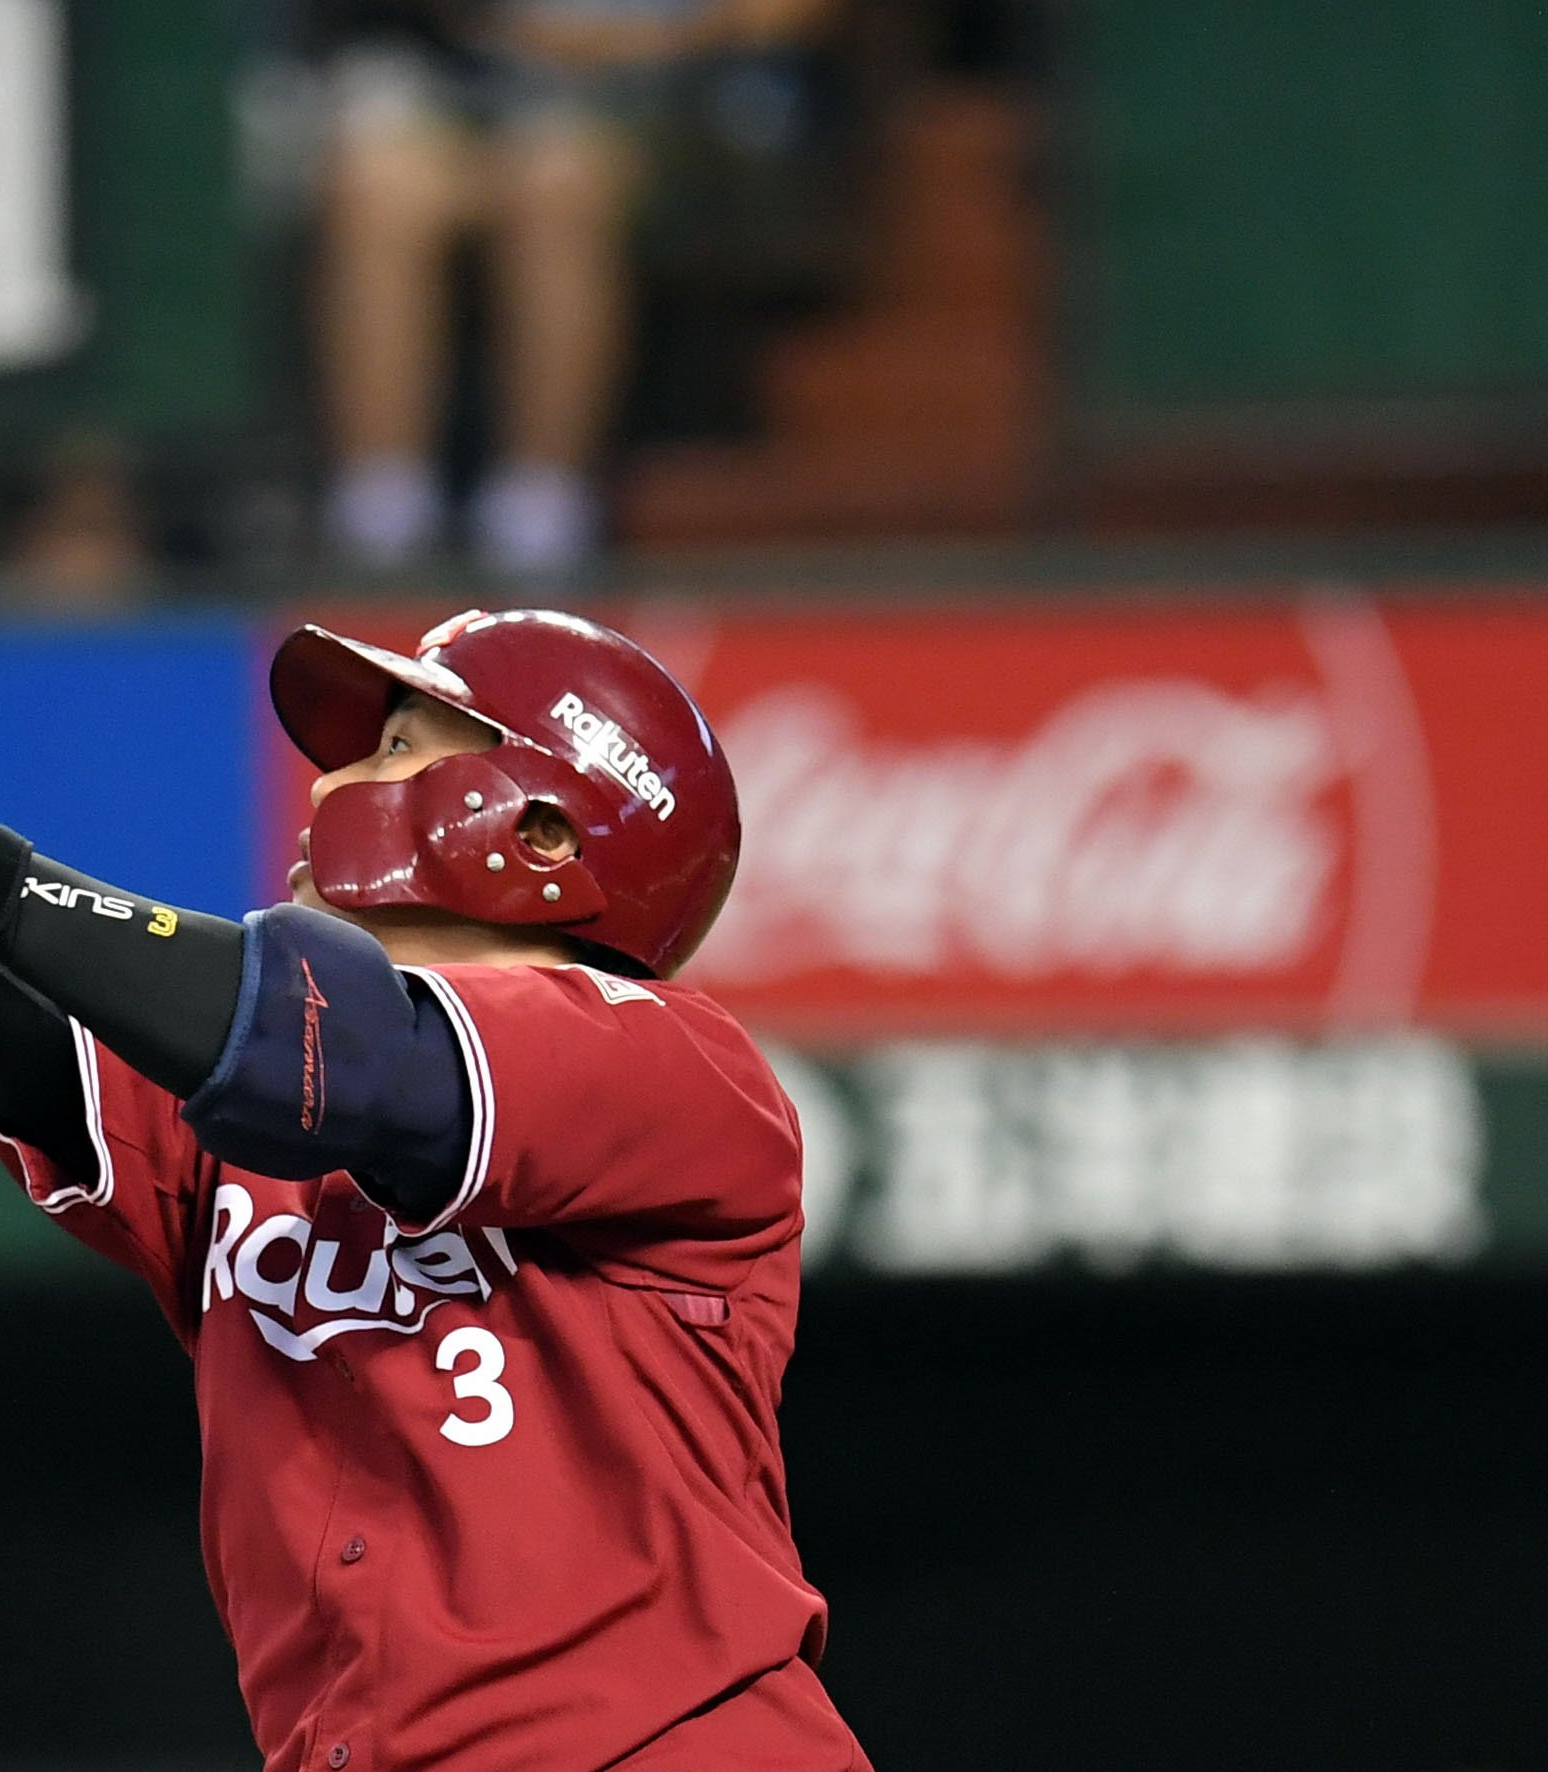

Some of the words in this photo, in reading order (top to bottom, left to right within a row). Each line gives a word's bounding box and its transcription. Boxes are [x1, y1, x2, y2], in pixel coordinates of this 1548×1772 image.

[550, 692, 676, 822] Rakuten
[20, 876, 136, 921] KINS
[147, 905, 179, 938] 3
[435, 1325, 515, 1447] 3
